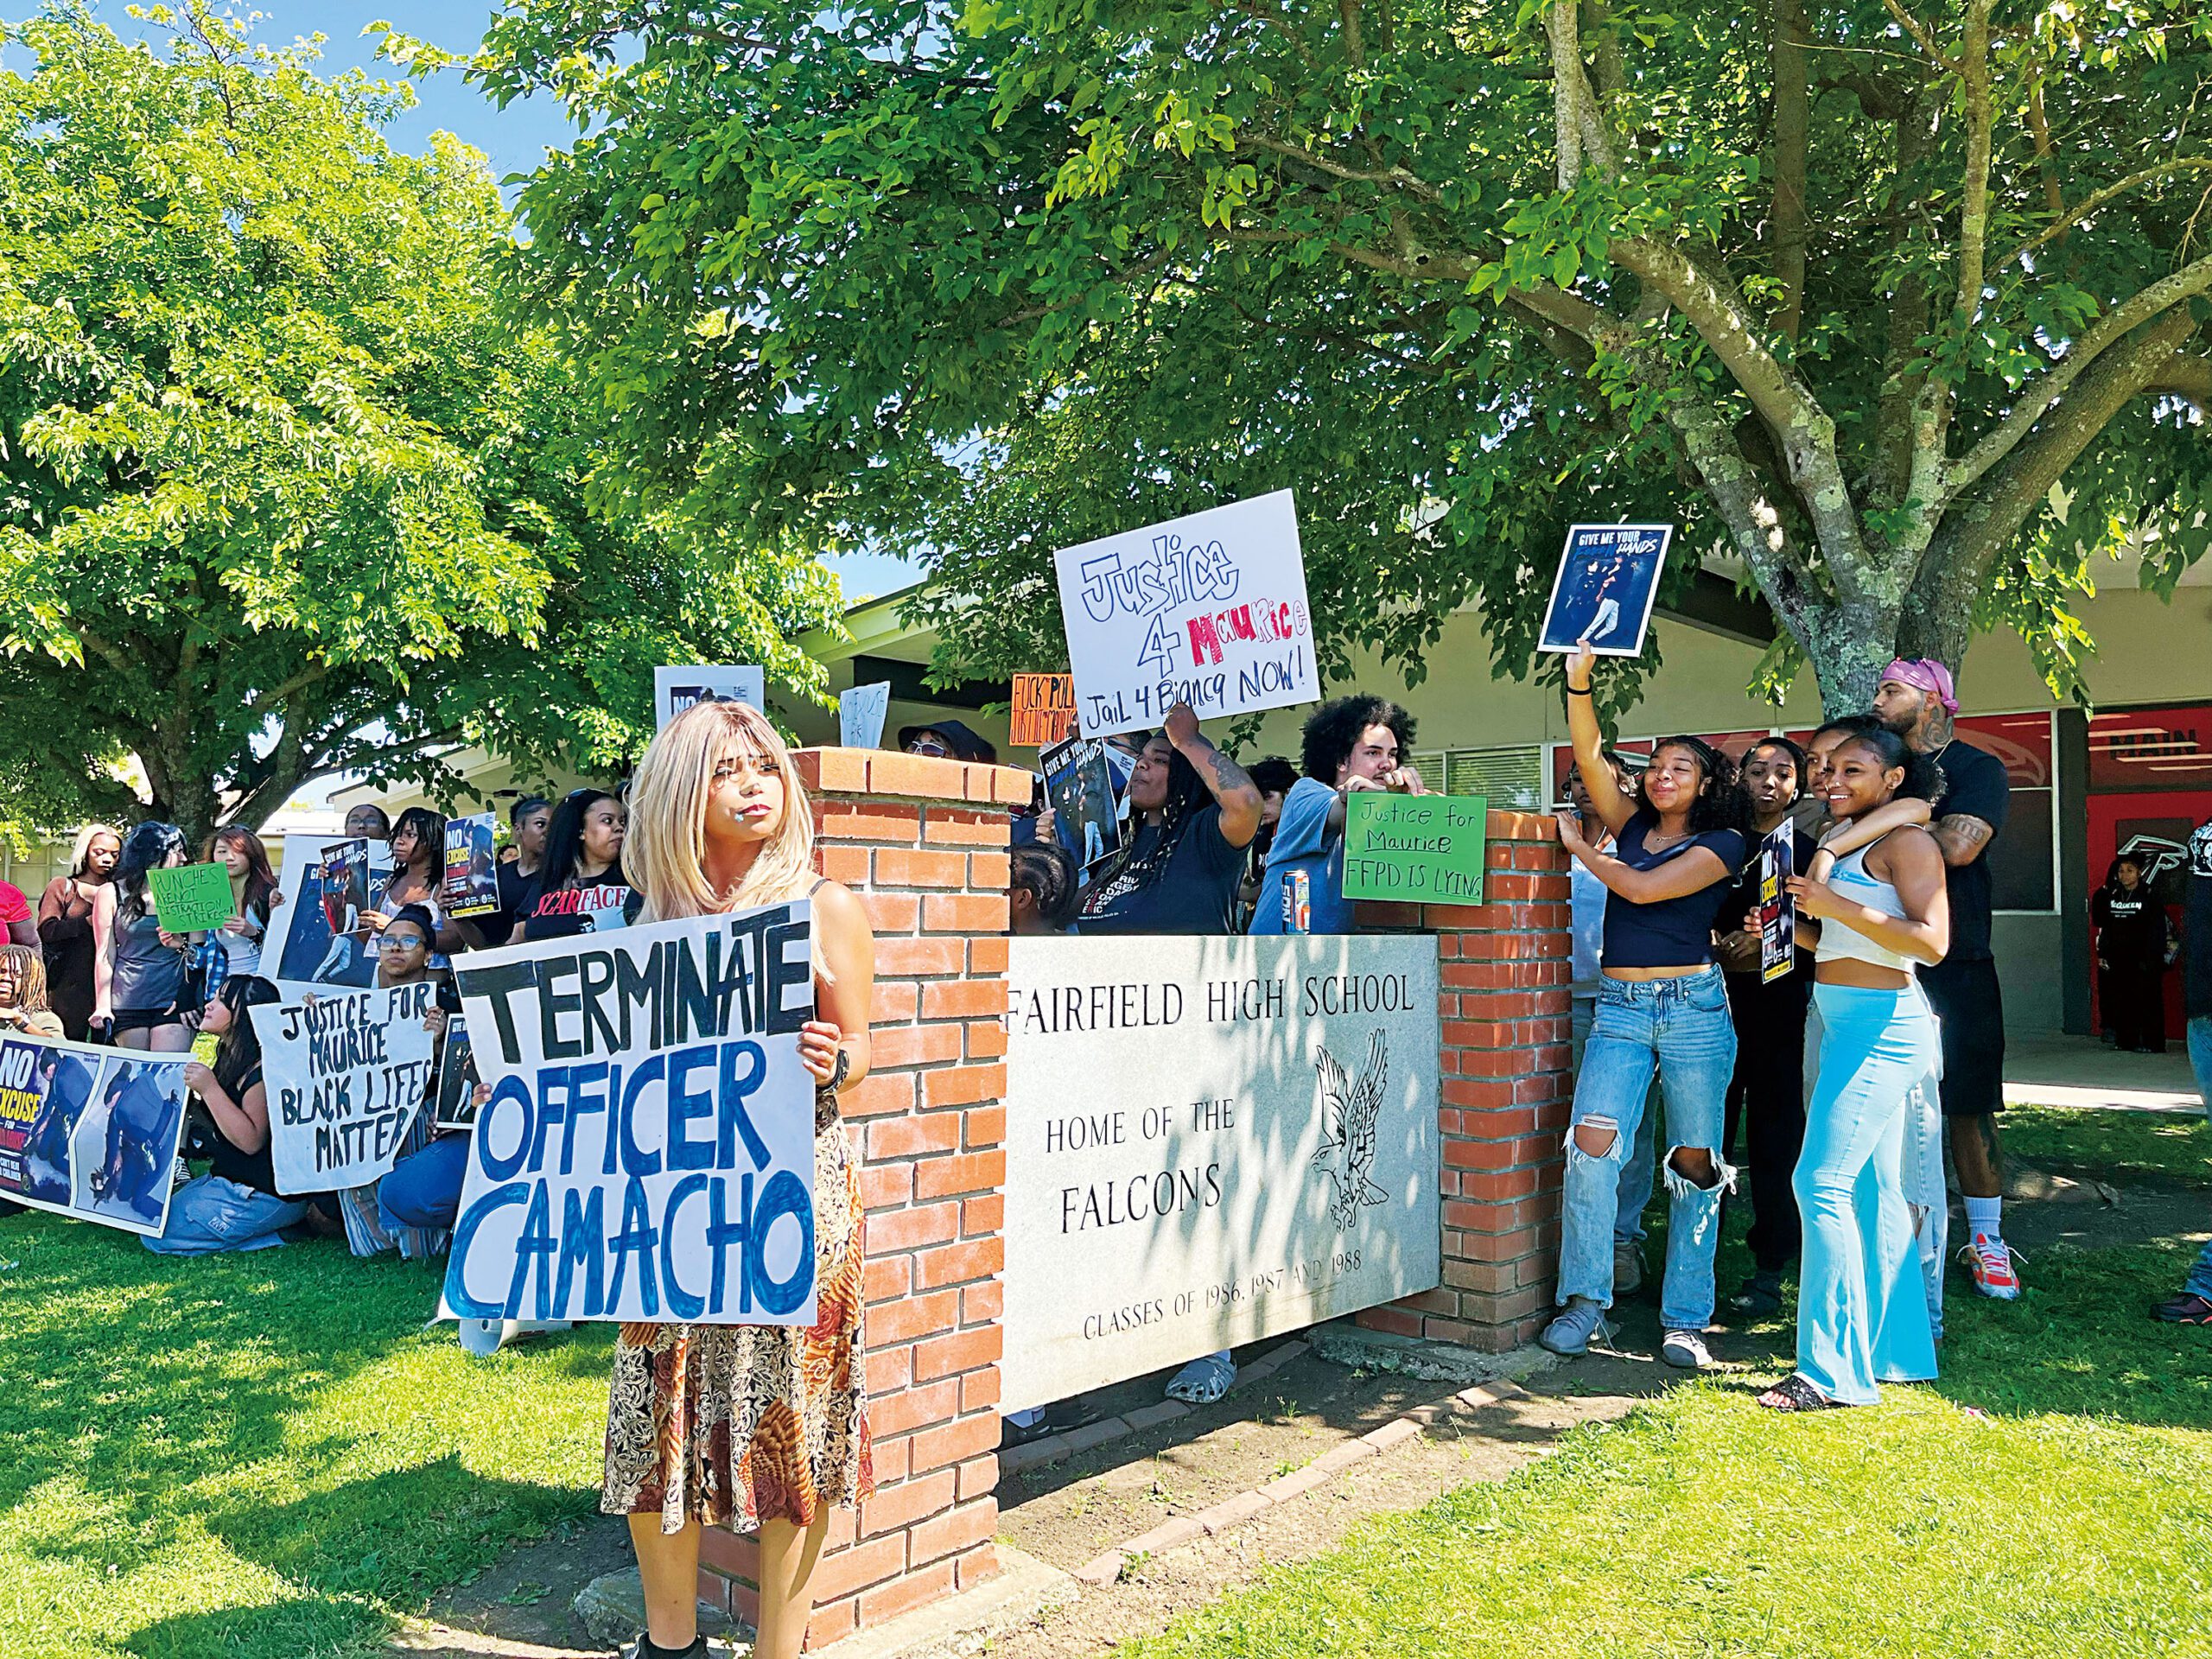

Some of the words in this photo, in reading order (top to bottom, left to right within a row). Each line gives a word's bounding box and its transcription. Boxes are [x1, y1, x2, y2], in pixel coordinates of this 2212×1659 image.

[1579, 533, 1599, 546] GIVE
[1600, 532, 1615, 544] ME
[1617, 531, 1640, 543] YOUR
[1616, 538, 1658, 556] HANDS
[1081, 535, 1239, 622] Justice
[1137, 613, 1181, 679] 4
[1014, 677, 1046, 709] FUCK
[1049, 677, 1075, 709] POLI
[1135, 685, 1150, 718] 4
[1240, 645, 1306, 704] NOW!
[1045, 755, 1061, 777] GIVE
[1058, 748, 1071, 766] ME
[1076, 738, 1103, 770] HANDS
[2110, 729, 2196, 760] MAIN
[1361, 802, 1432, 824] Justice
[1445, 804, 1476, 828] for
[446, 829, 462, 849] NO
[1367, 830, 1452, 853] Maurice
[154, 867, 219, 894] PUNCHES
[156, 893, 175, 907] ARE
[174, 888, 198, 903] NOT
[1345, 859, 1401, 887] FFPD
[1408, 864, 1427, 887] IS
[1434, 868, 1481, 897] LYING
[531, 886, 626, 918] SCARFACE
[456, 906, 815, 1064] TERMINATE
[1006, 983, 1183, 1036] FAIRFIELD
[1206, 979, 1284, 1022] HIGH
[1305, 975, 1414, 1017] SCHOOL
[280, 994, 372, 1040] JUSTICE
[389, 982, 430, 1022] FOR
[0, 1046, 35, 1090] NO
[309, 1022, 390, 1078] MAURICE
[281, 1076, 352, 1125] BLACK
[478, 1040, 772, 1182] OFFICER
[316, 1107, 409, 1173] MATTER
[1046, 1112, 1126, 1154] HOME
[1142, 1106, 1173, 1140] OF
[1190, 1098, 1235, 1133] THE
[1060, 1163, 1221, 1235] FALCONS
[445, 1169, 815, 1319] CAMACHO
[1084, 1299, 1164, 1340] CLASSES
[1173, 1291, 1196, 1317] OF
[1205, 1281, 1245, 1309] 1986,
[1251, 1269, 1284, 1297] 1987
[1294, 1259, 1322, 1284] AND
[1332, 1249, 1362, 1275] 1988
